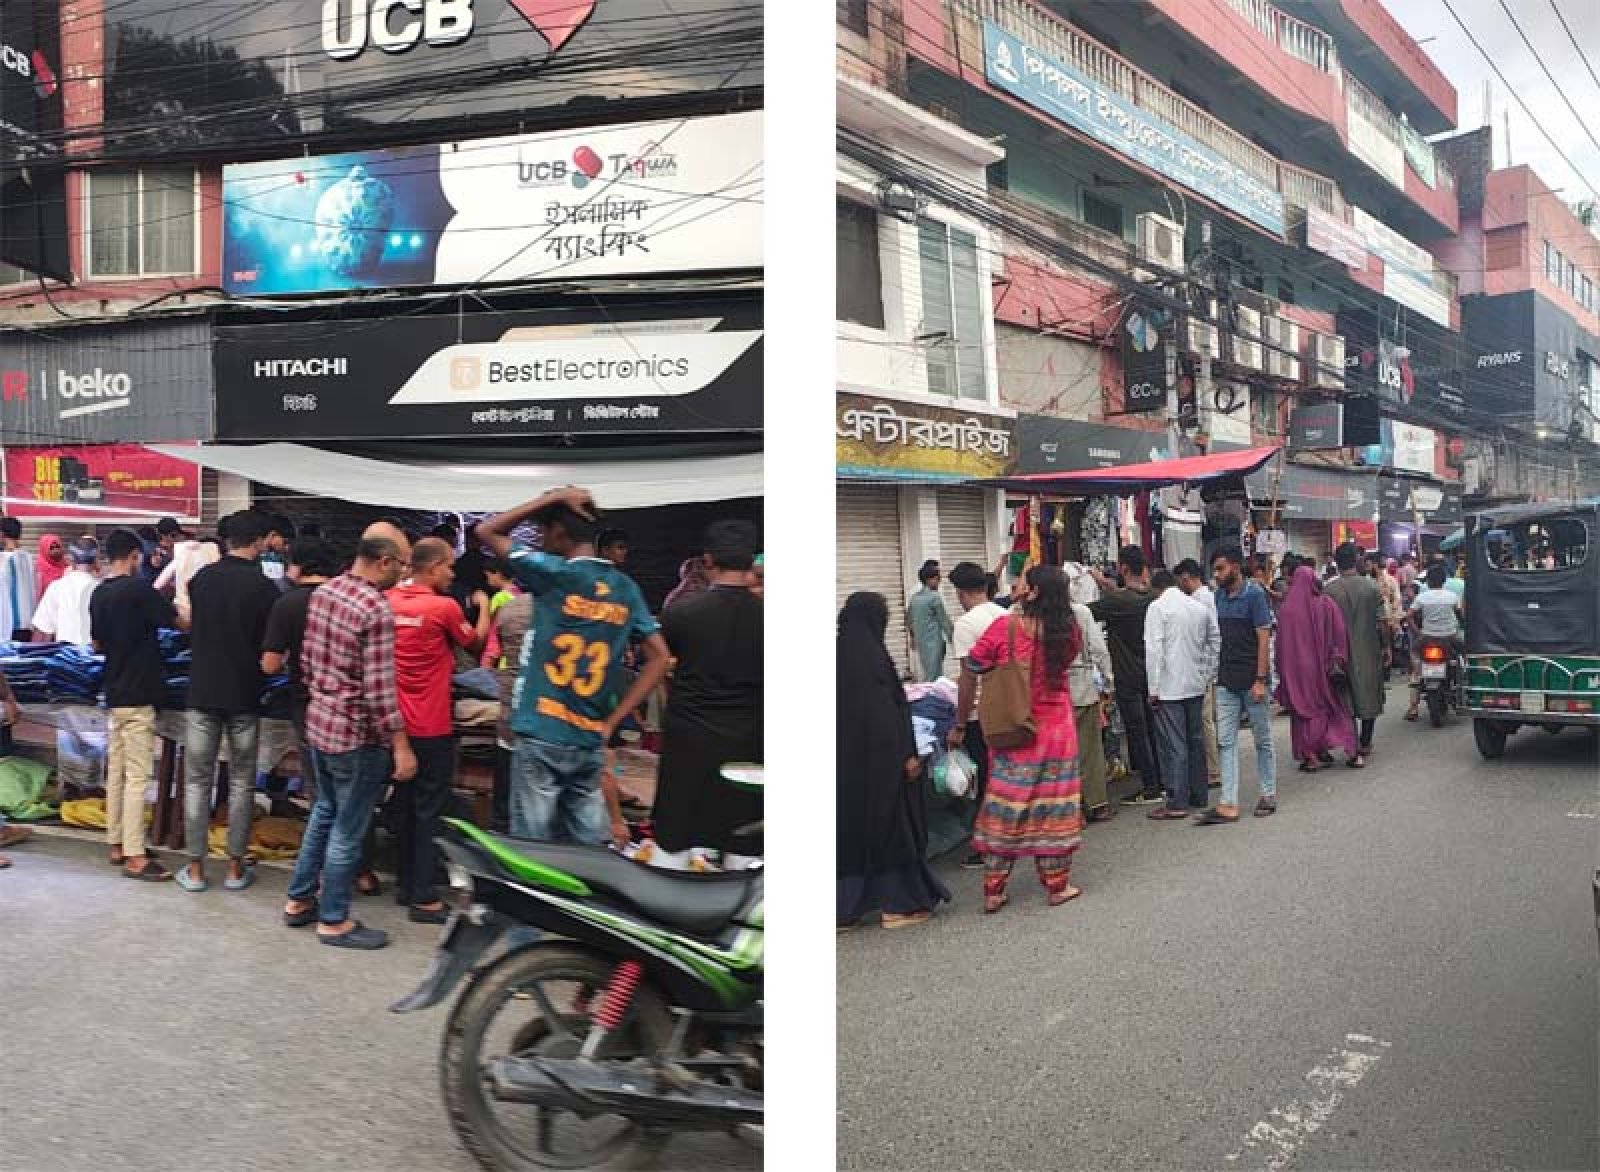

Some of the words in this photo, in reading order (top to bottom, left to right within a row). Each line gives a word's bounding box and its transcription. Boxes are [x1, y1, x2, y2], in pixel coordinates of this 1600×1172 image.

[321, 0, 474, 60] UCB
[0, 44, 31, 77] CB
[518, 160, 567, 182] UCB
[58, 367, 131, 399] beko
[254, 357, 348, 377] HITACHI
[487, 353, 690, 384] BestElectronics
[543, 632, 610, 698] 33
